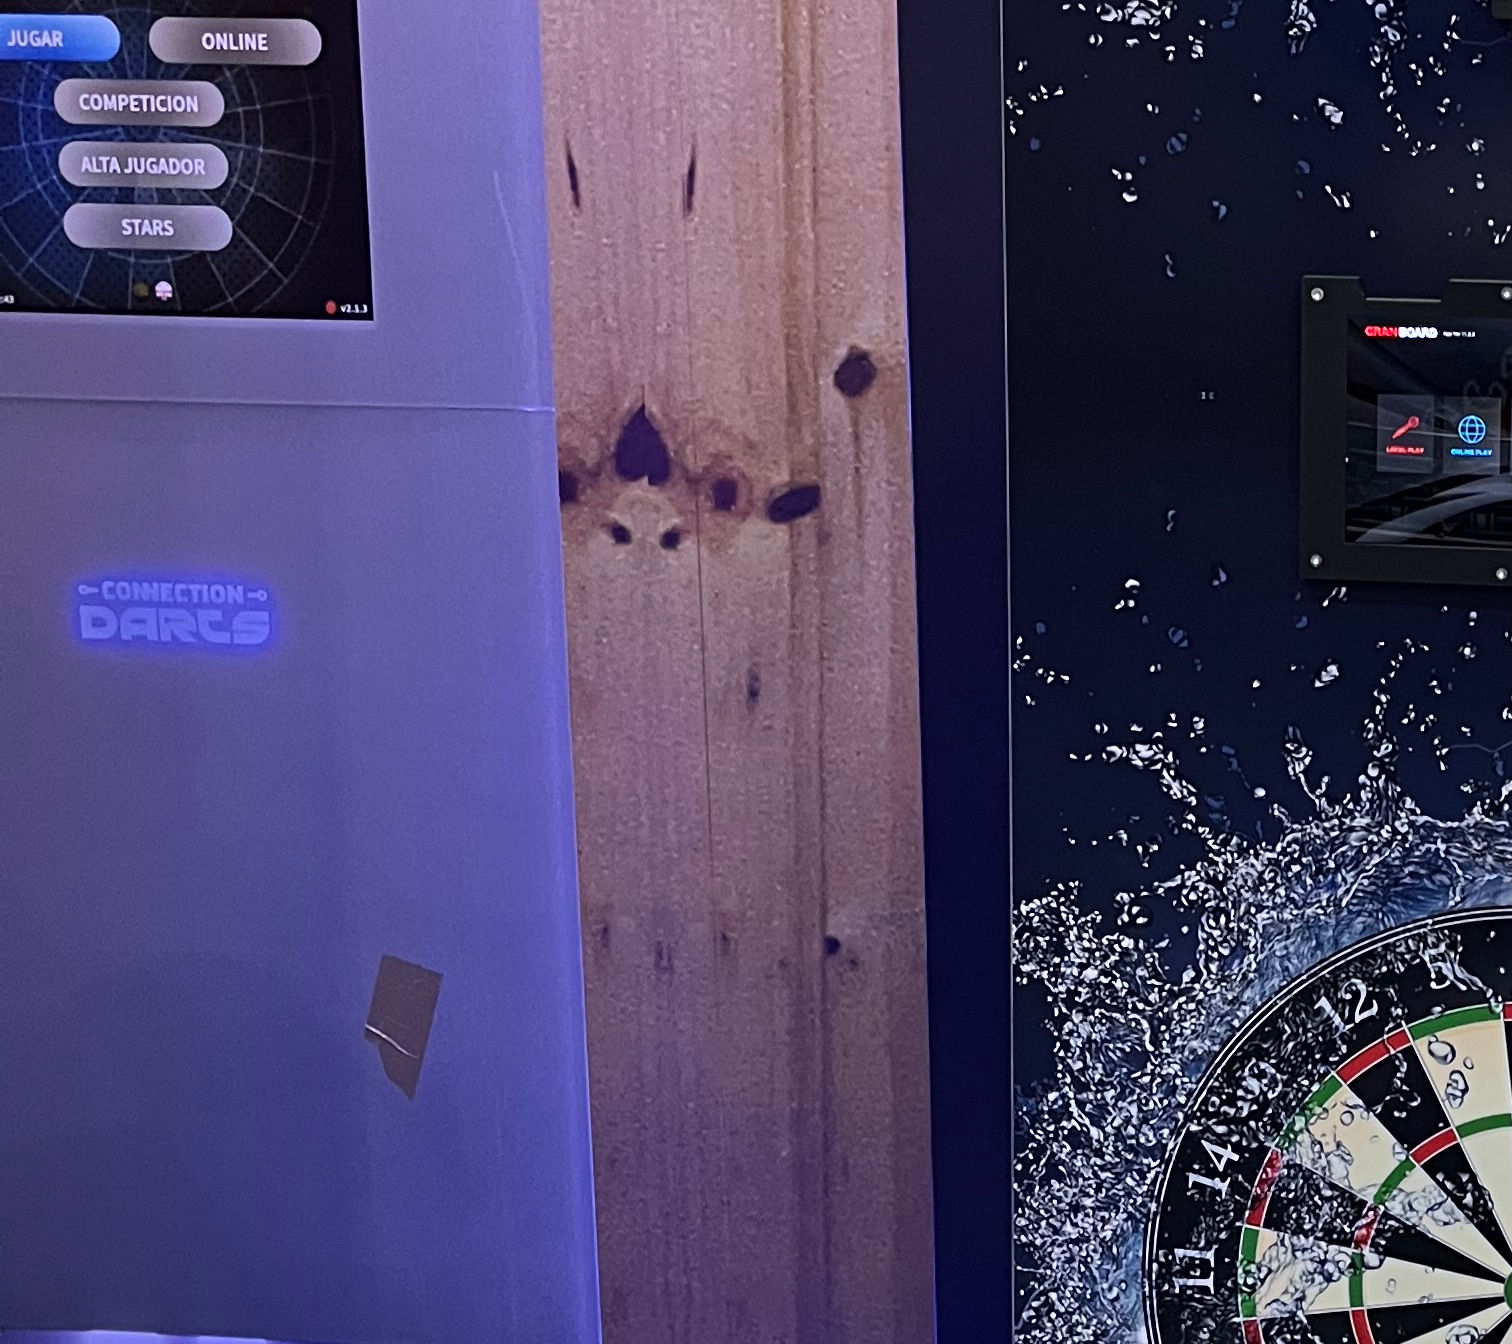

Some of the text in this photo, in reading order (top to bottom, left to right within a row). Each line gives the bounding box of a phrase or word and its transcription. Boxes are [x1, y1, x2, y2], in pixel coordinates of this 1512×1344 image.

[7, 30, 63, 48] JUGAR
[201, 32, 269, 51] ONLINE
[79, 93, 199, 113] COMPETICION
[81, 156, 206, 176] ALTA JUGADOR
[121, 218, 174, 236] STARS
[102, 581, 244, 604] CONNECTION
[80, 605, 270, 644] DARTS
[1314, 978, 1378, 1037] 12
[1187, 1139, 1240, 1198] 14
[1174, 1245, 1215, 1294] 11
